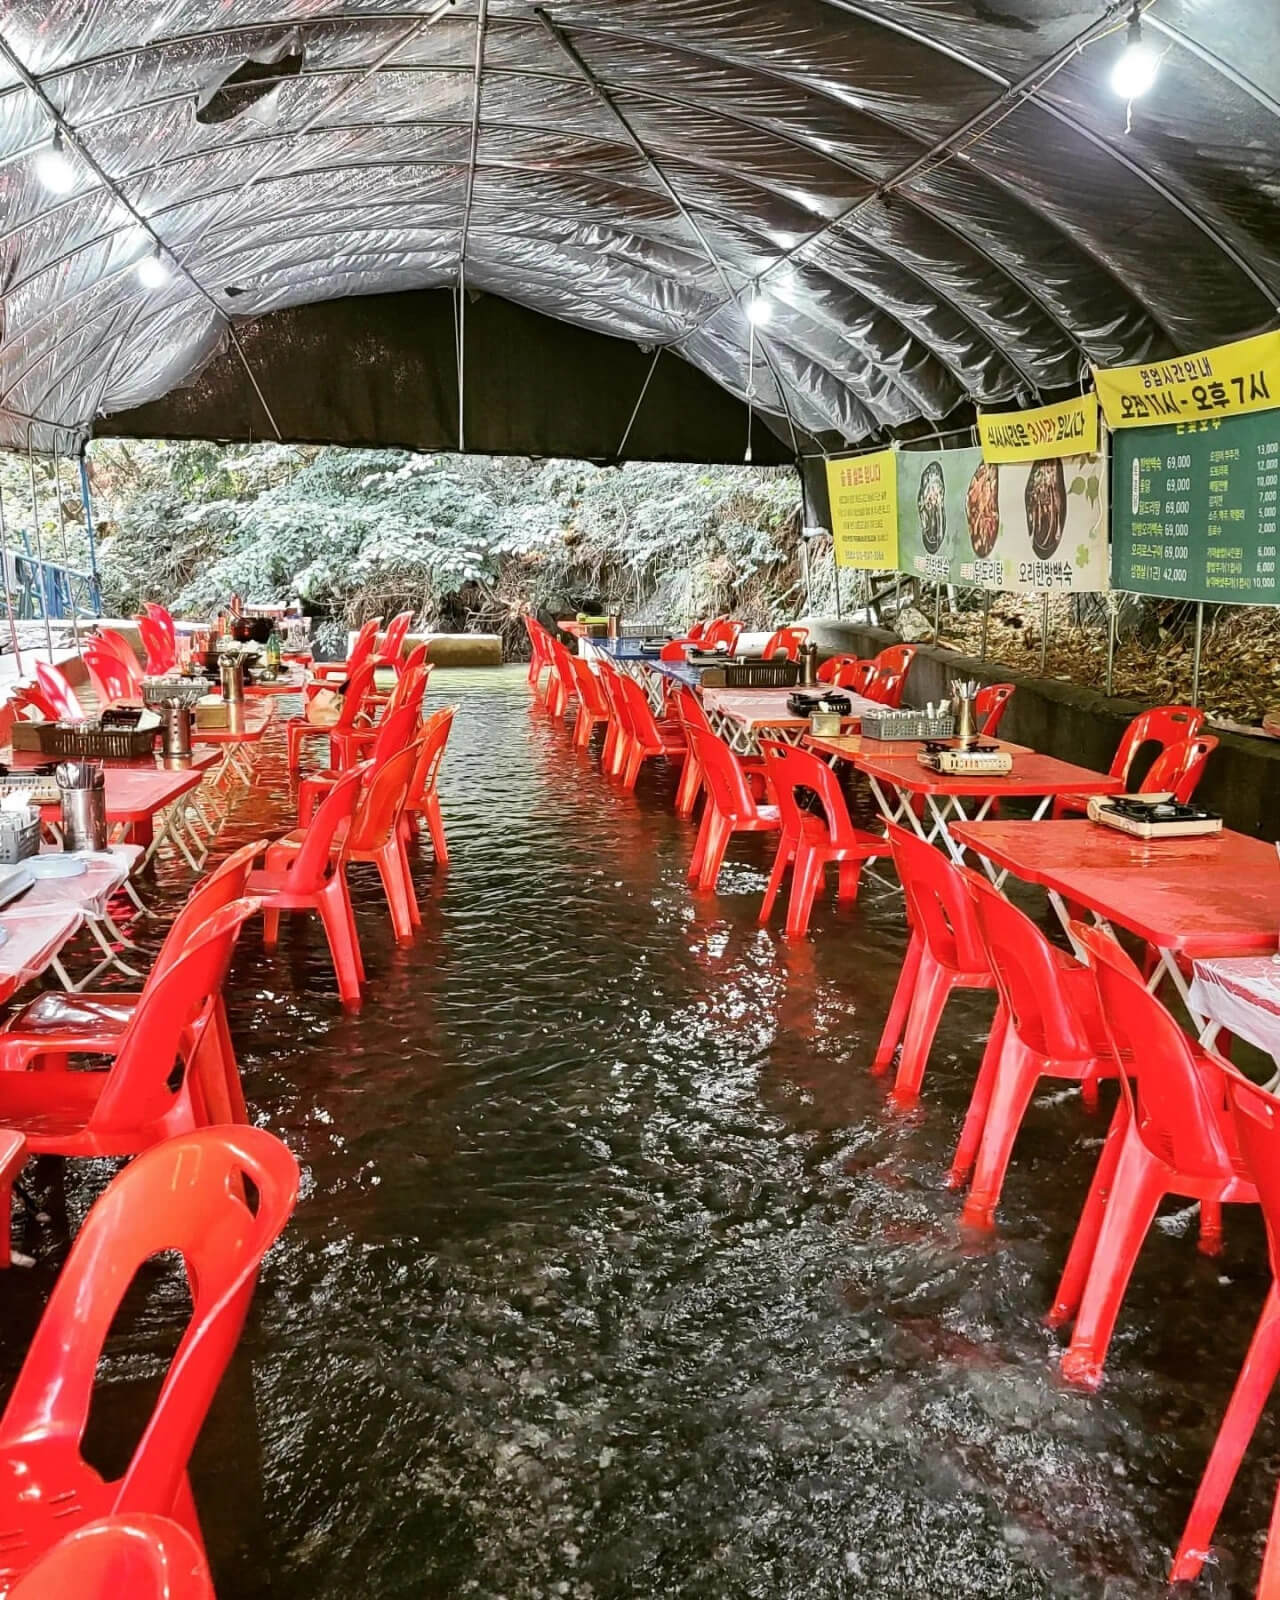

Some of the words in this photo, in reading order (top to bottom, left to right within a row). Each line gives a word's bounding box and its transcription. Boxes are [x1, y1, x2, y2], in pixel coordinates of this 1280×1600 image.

[1140, 356, 1213, 388] 영업시간안내
[1191, 381, 1230, 411] 오후
[1231, 370, 1271, 404] 7시
[987, 423, 1030, 448] 식사시간은
[1026, 418, 1056, 444] 3시간
[1056, 411, 1085, 440] 입니다
[1257, 442, 1279, 455] 13,000
[1166, 454, 1191, 470] 69,000
[1166, 478, 1190, 493] 69,000
[1258, 490, 1277, 503] 7,000
[1165, 500, 1190, 515] 69,000
[1164, 523, 1189, 538] 69,000
[1164, 545, 1188, 560] 69,000
[1019, 560, 1073, 586] 오리한방백숙
[1163, 567, 1187, 582] 42,000
